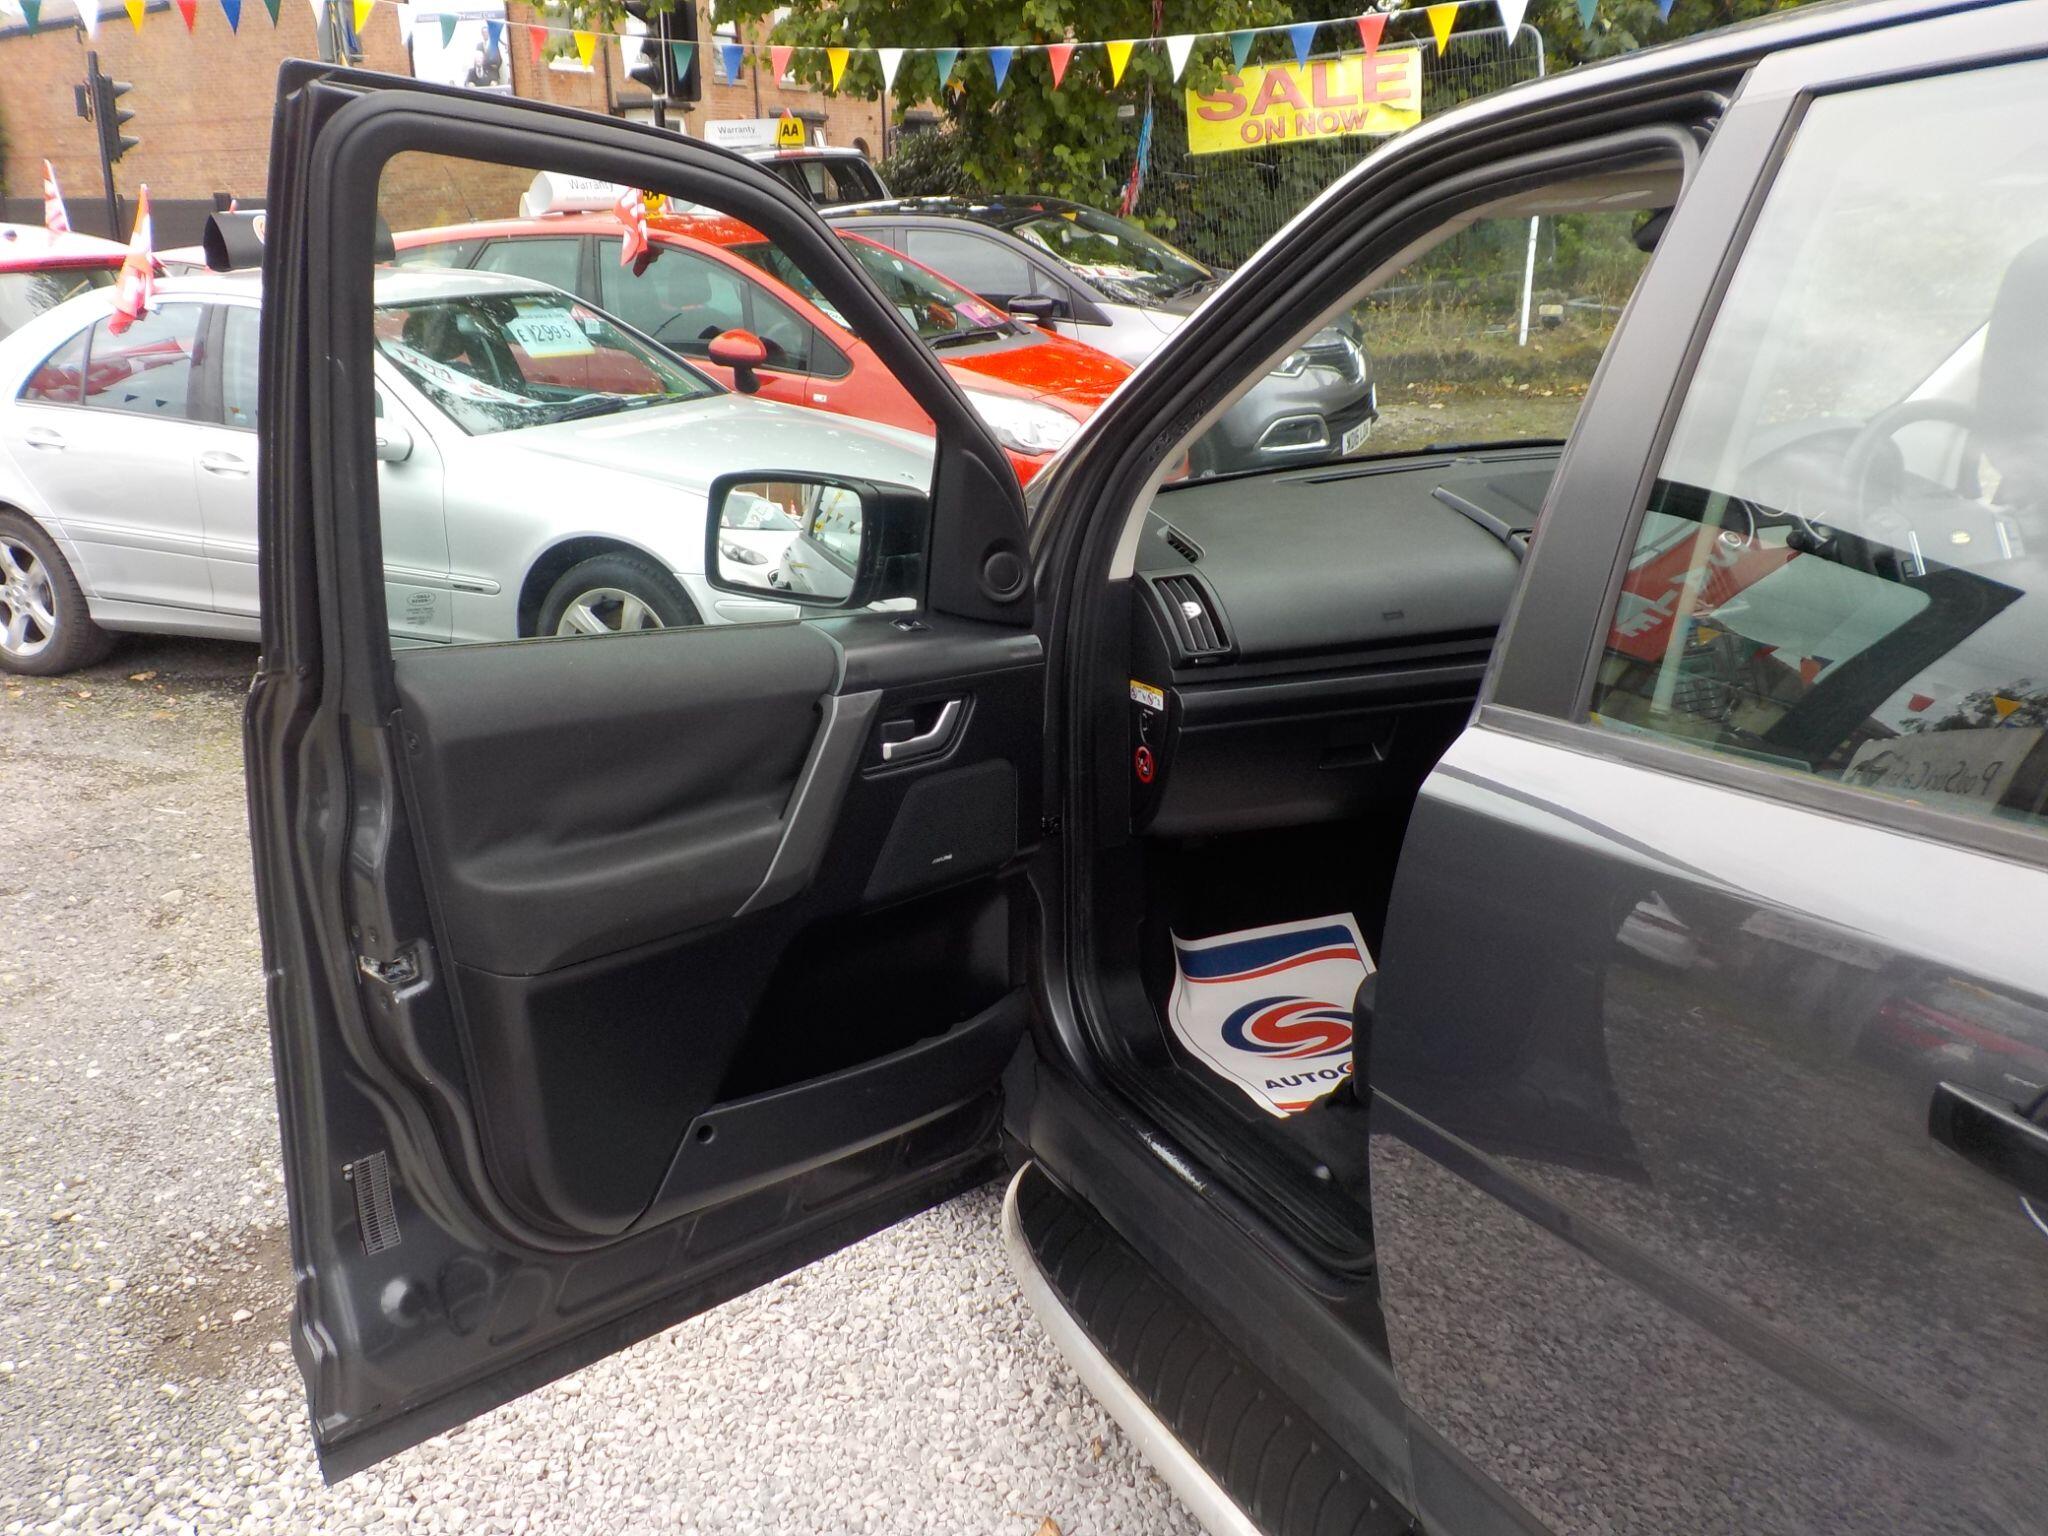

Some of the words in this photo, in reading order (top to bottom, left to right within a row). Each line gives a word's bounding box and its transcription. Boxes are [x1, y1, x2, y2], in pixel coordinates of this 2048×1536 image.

[1197, 54, 1411, 121] SALE
[717, 126, 756, 134] Warranty
[782, 124, 799, 136] AA
[1241, 118, 1286, 143] ON
[1295, 110, 1369, 136] NOW
[568, 178, 614, 192] Warranty
